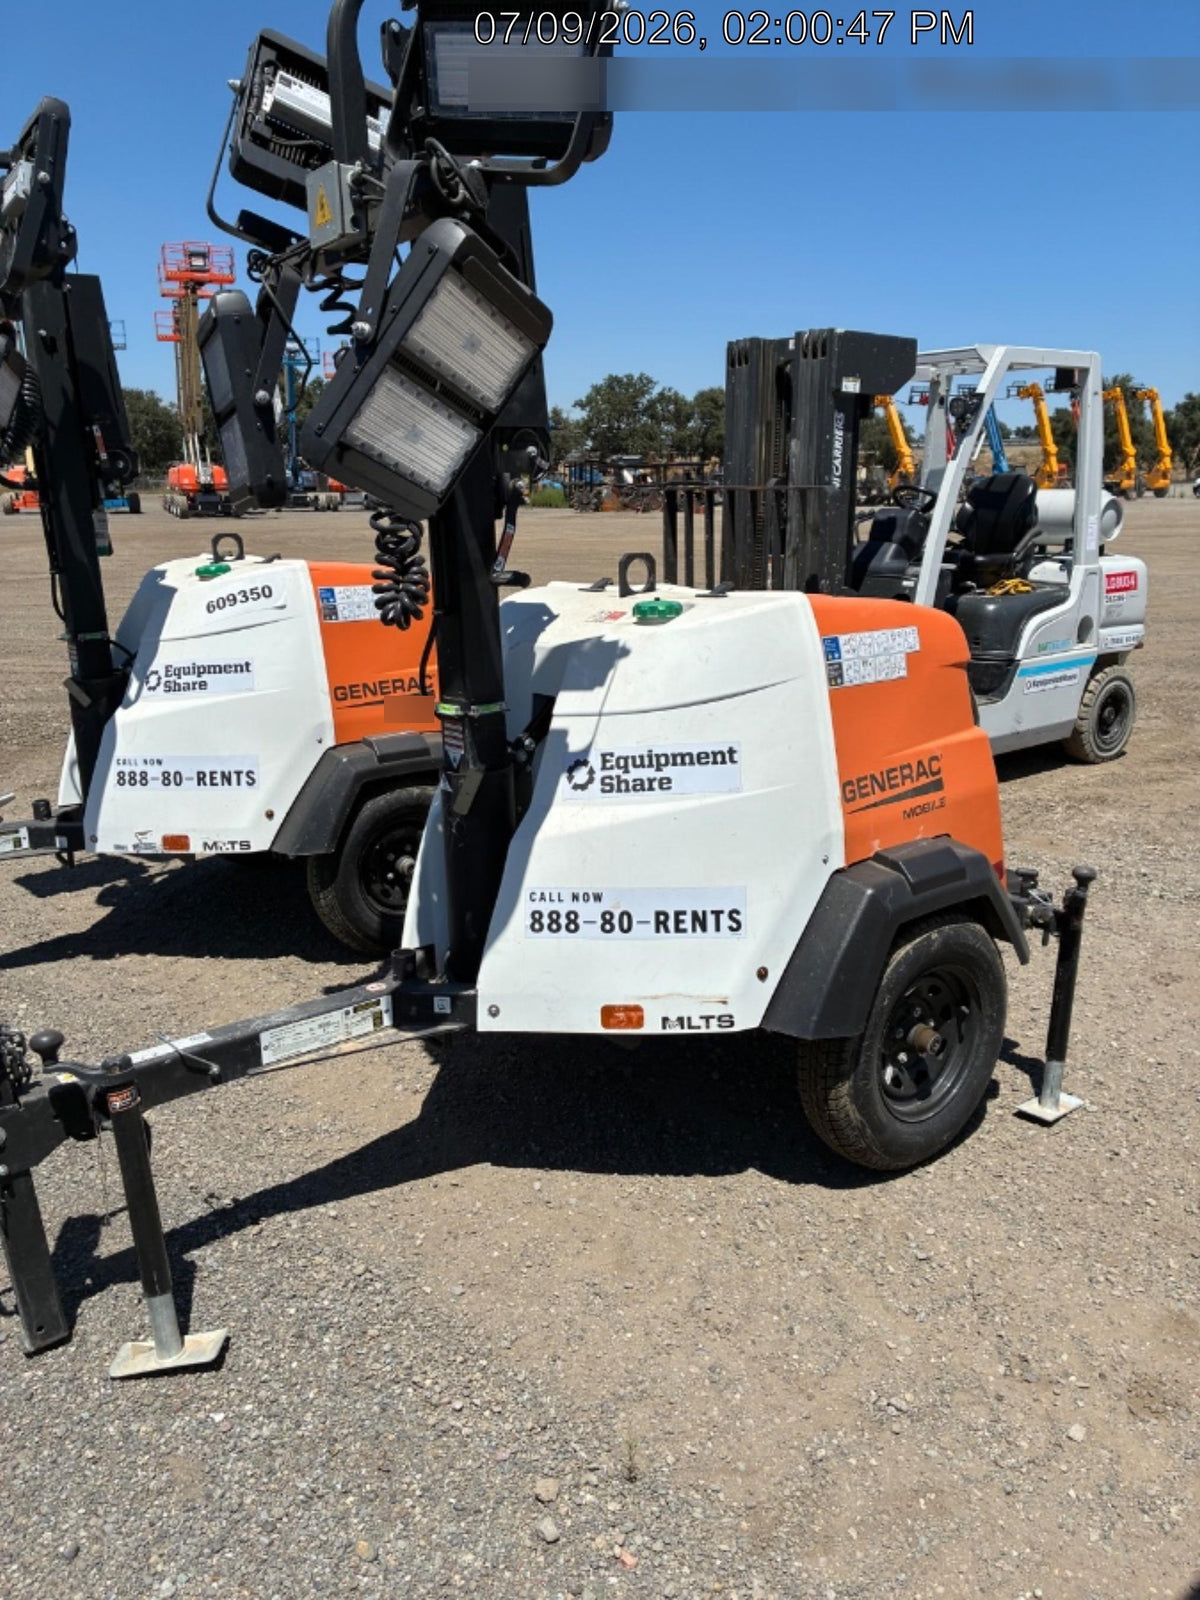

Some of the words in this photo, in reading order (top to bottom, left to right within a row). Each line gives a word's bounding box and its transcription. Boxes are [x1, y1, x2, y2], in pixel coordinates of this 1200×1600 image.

[205, 584, 274, 615] 609350
[164, 661, 252, 680] Equipment
[163, 680, 209, 693] Share
[116, 758, 139, 767] CALL
[143, 758, 164, 767] NOW
[600, 746, 739, 774] Equipment
[116, 769, 257, 787] 888-80-RENTS
[600, 774, 673, 794] Share
[841, 755, 942, 804] GENERAC
[529, 891, 564, 903] CALL
[571, 891, 604, 903] NOW
[529, 908, 742, 935] 888-80-RENTS
